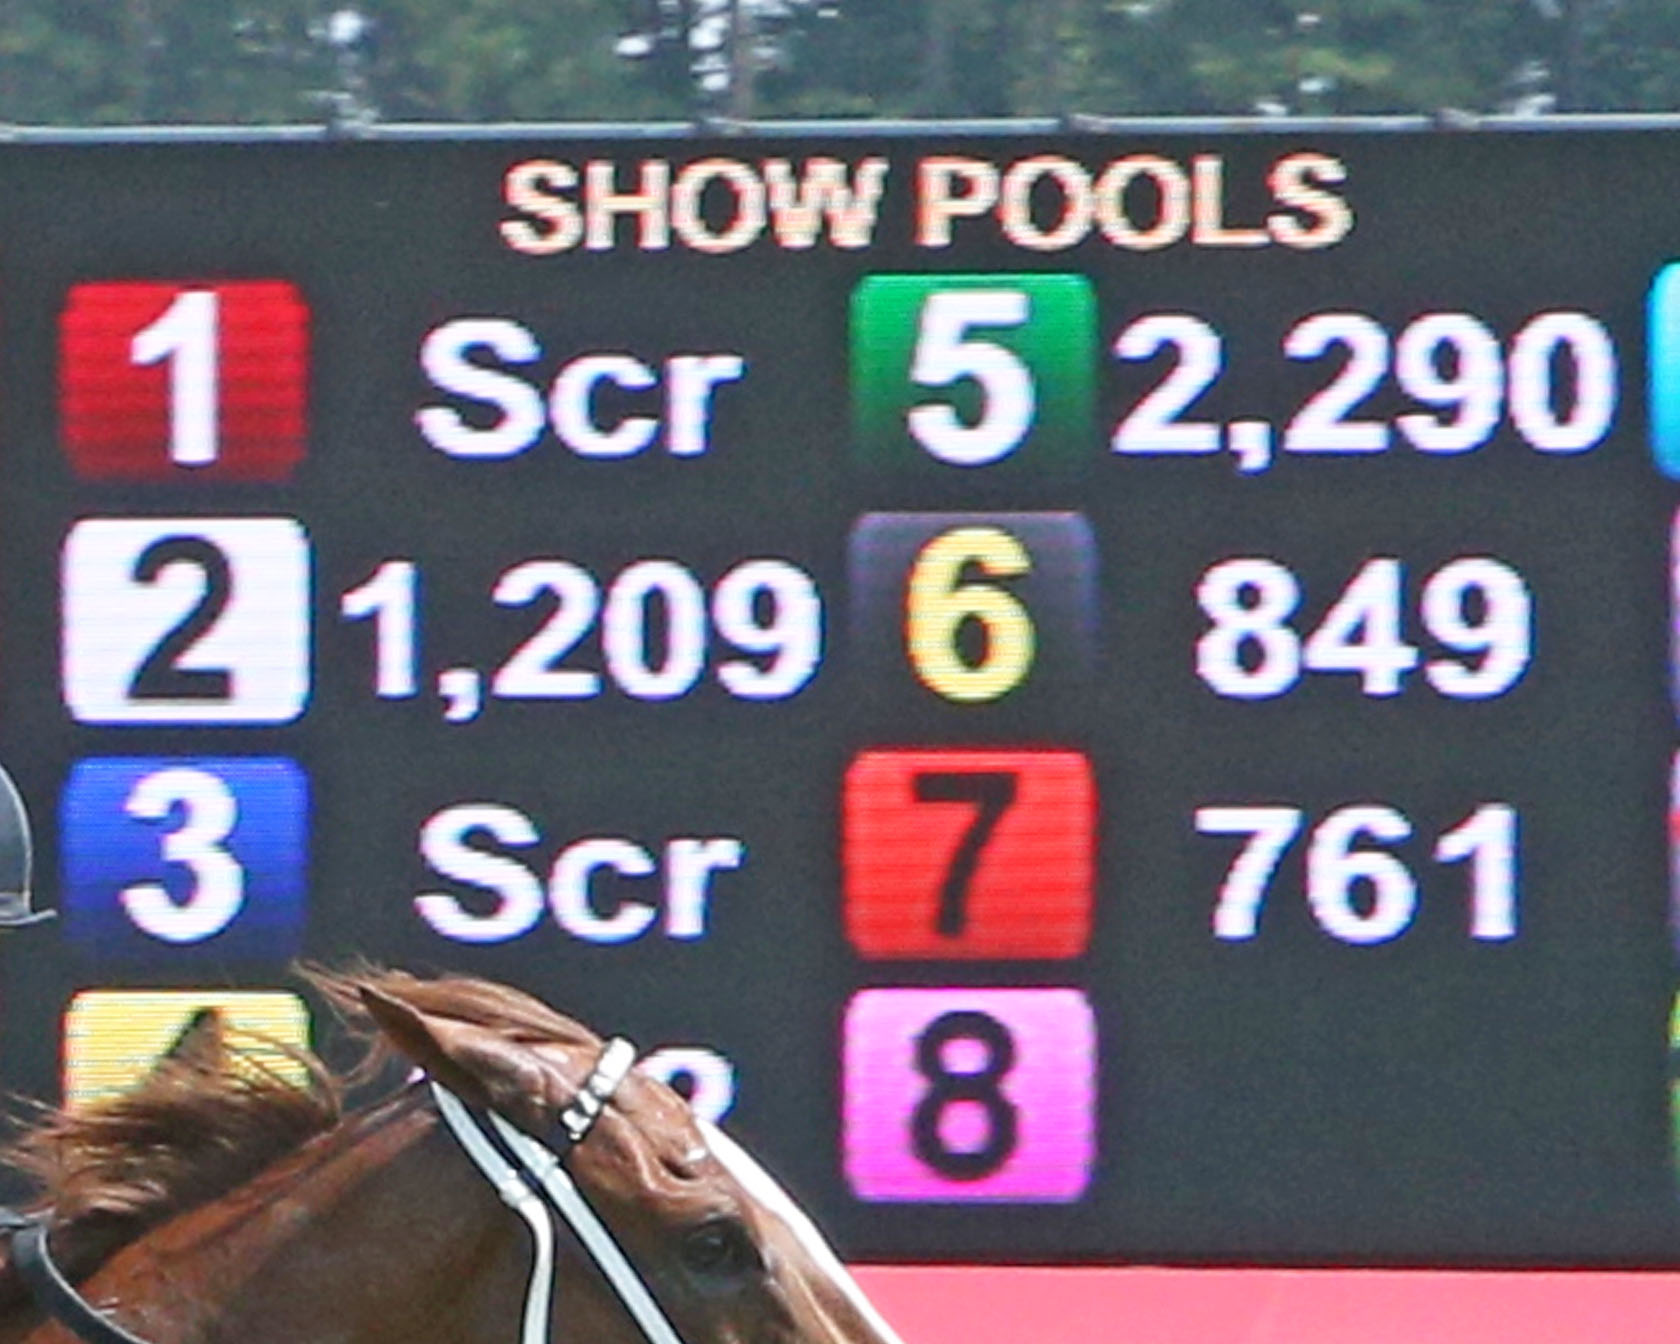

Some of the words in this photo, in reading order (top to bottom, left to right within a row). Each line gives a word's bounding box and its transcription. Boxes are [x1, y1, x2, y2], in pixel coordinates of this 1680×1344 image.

[500, 159, 889, 253] SHOW
[914, 153, 1355, 250] POOLS
[131, 291, 221, 463] 1
[416, 318, 744, 459] Scr
[907, 291, 1035, 465] 5
[1110, 312, 1615, 472] 2,290
[127, 535, 234, 701] 2
[341, 561, 822, 720] 1,209
[907, 526, 1035, 702] 6
[1196, 558, 1532, 698] 849
[122, 769, 244, 943] 3
[414, 803, 743, 943] Scr
[912, 771, 1019, 937] 7
[1194, 804, 1517, 945] 761
[910, 1011, 1018, 1181] 8
